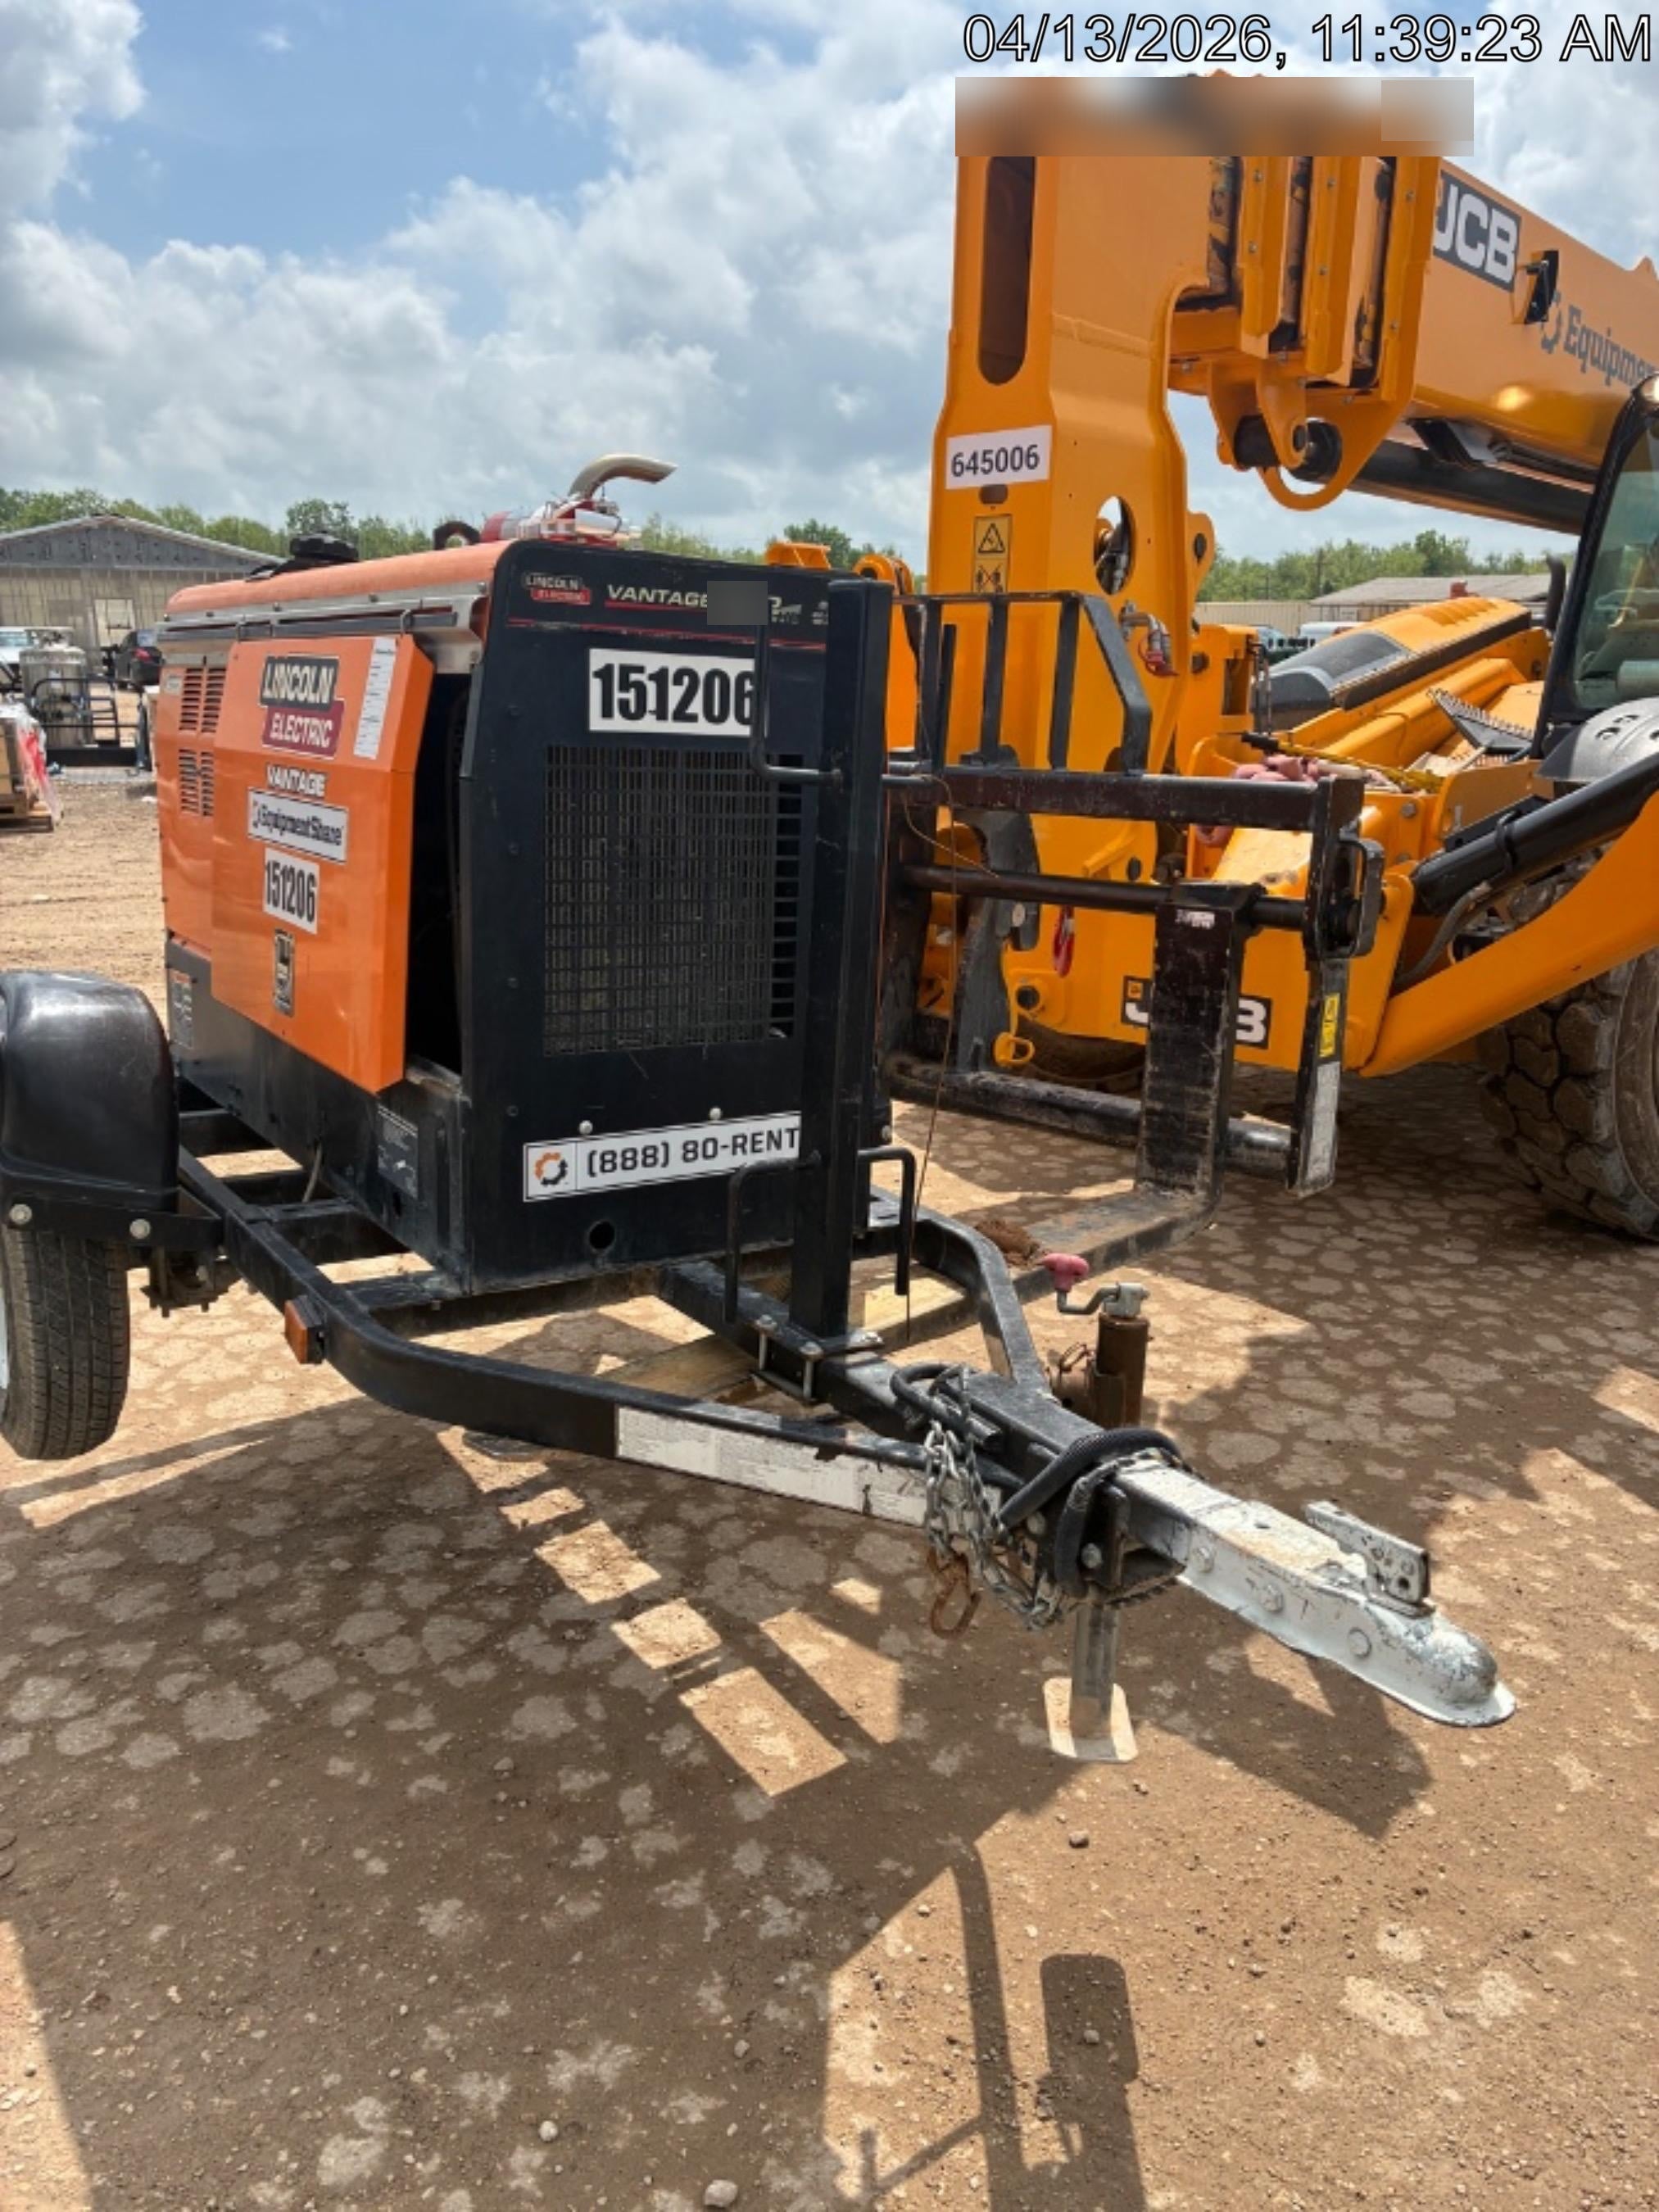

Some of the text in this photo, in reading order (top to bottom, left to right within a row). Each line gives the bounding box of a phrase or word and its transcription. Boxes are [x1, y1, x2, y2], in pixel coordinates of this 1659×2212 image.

[1434, 184, 1516, 283] JCB
[951, 445, 1040, 477] 645006
[262, 662, 334, 704] LINCOLN
[592, 663, 754, 726] 151206
[270, 712, 333, 748] ELECTRIC
[266, 764, 326, 797] VANTAGE
[265, 860, 317, 922] 151206
[587, 1127, 800, 1177] (888) 80-RENT
